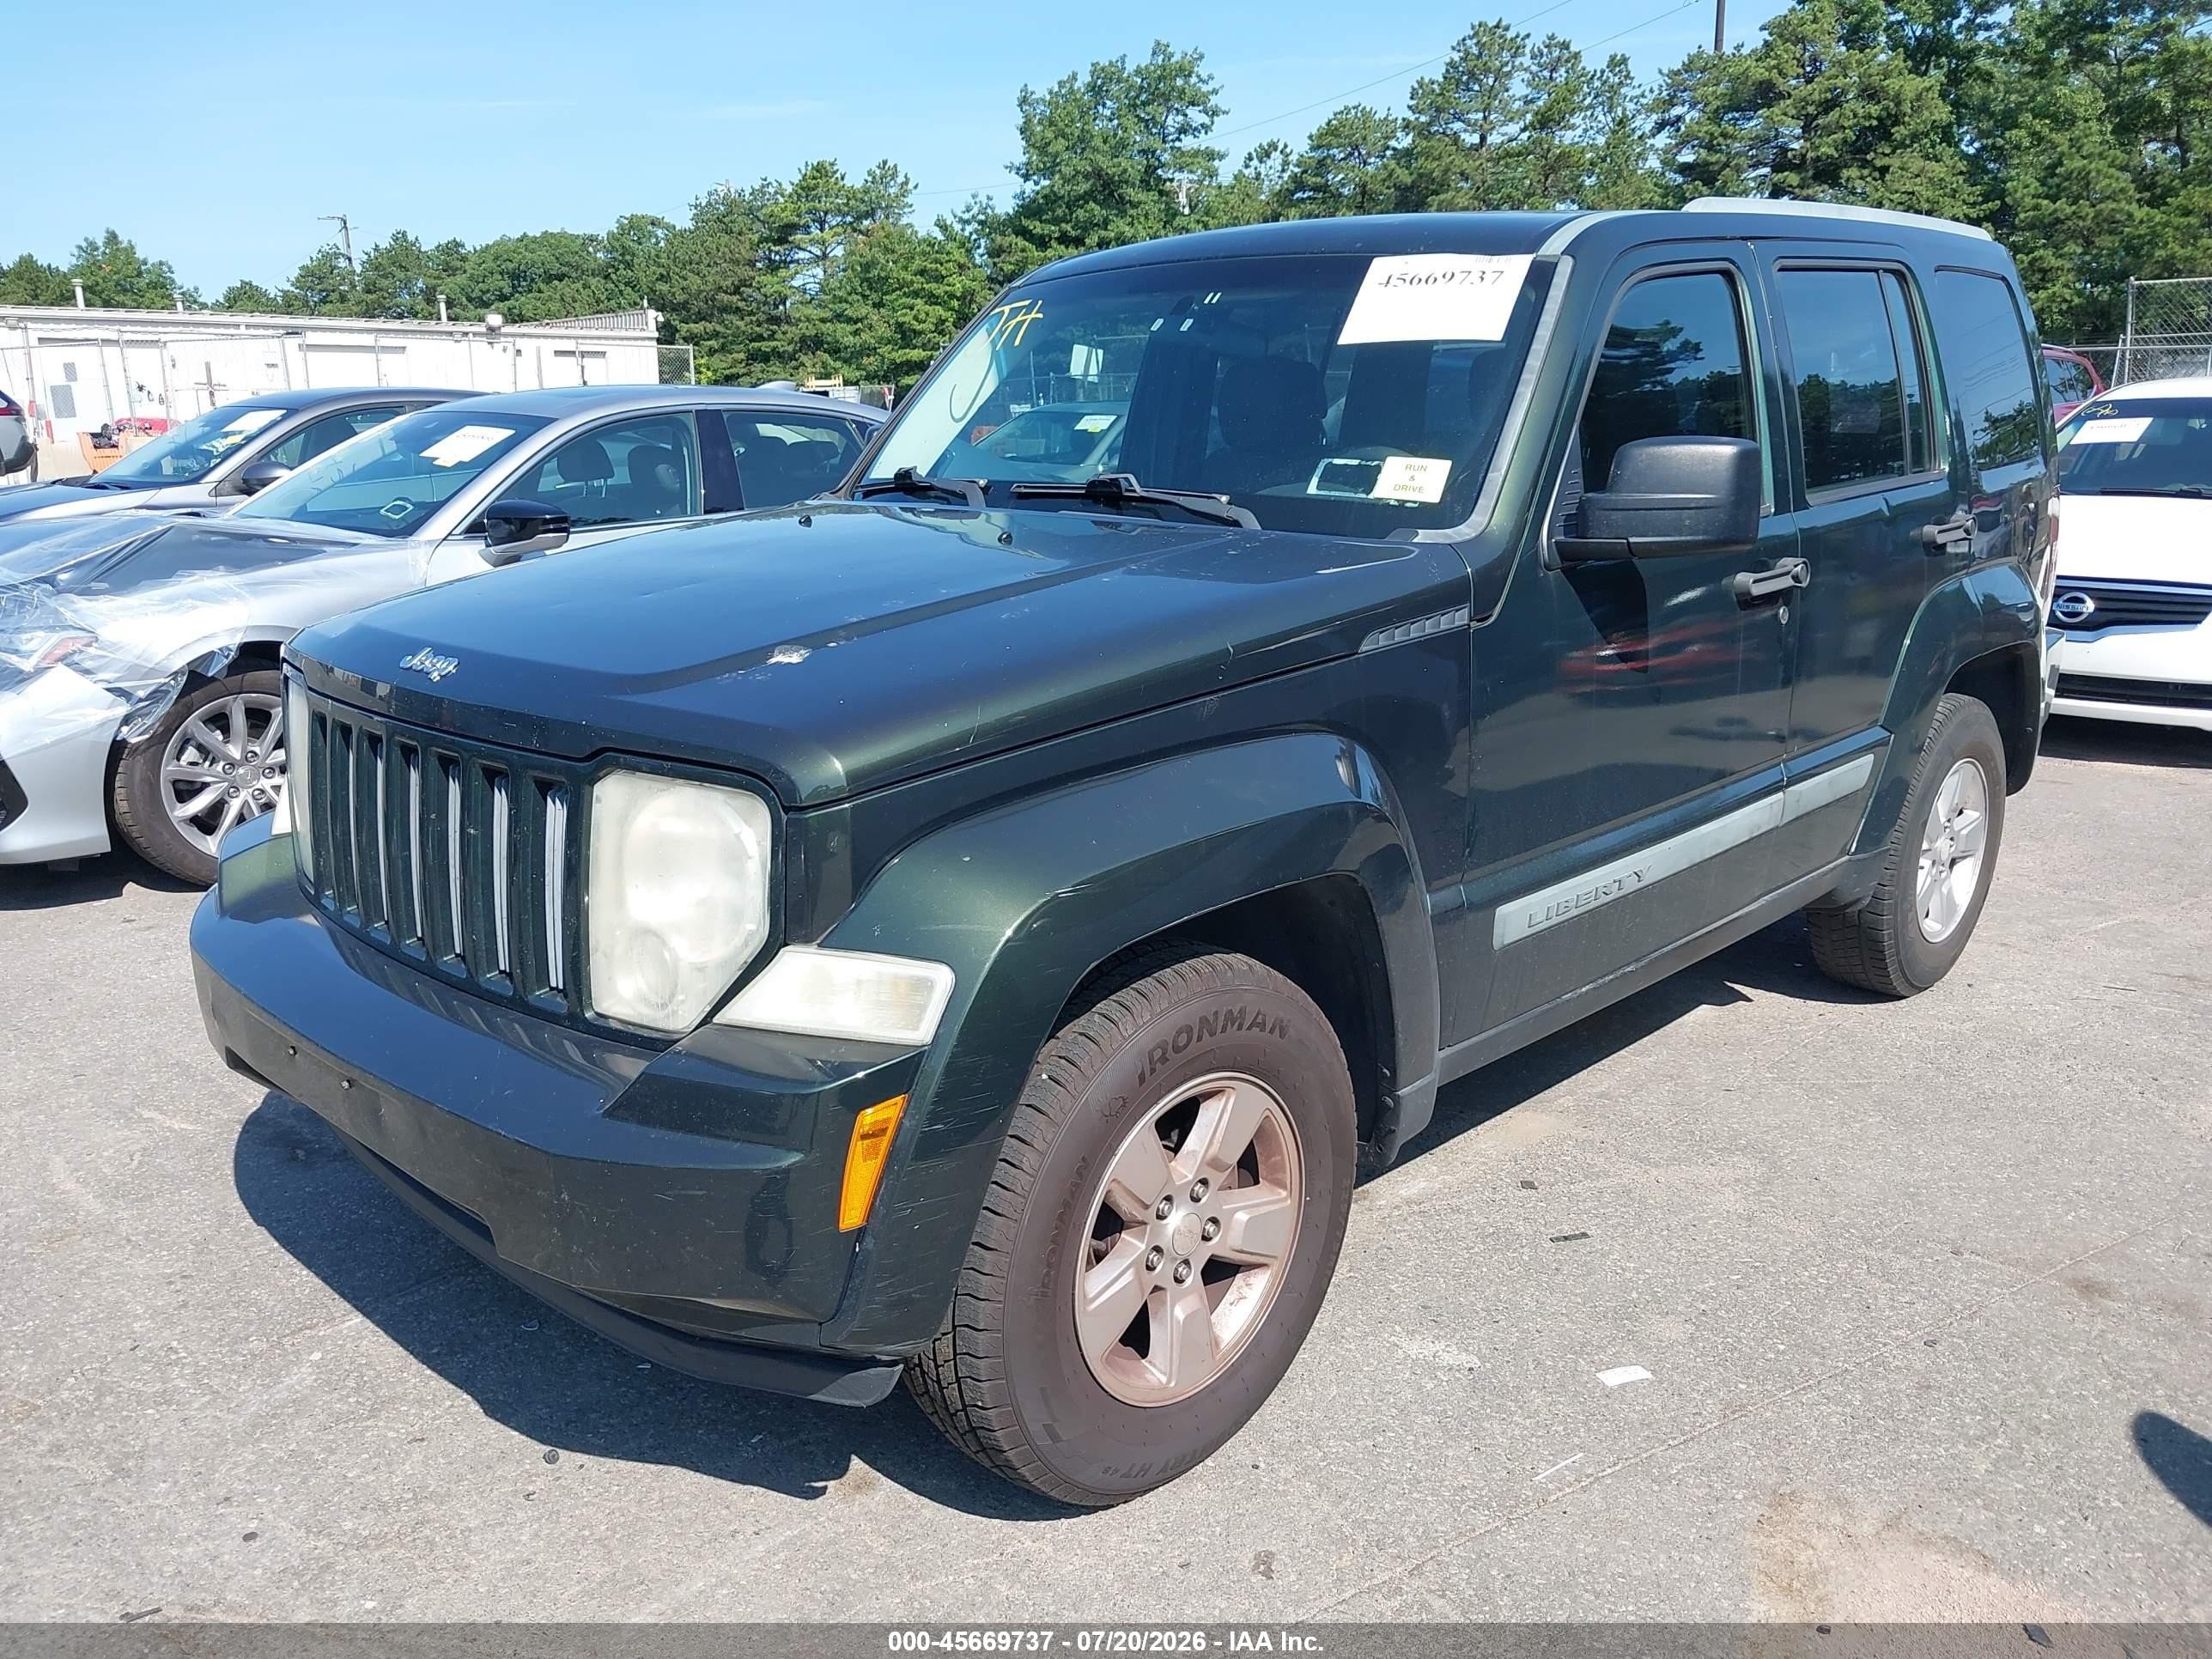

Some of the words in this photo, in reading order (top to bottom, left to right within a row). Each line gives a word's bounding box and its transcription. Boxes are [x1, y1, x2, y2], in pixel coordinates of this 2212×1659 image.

[1377, 270, 1505, 288] 45669737
[1404, 464, 1428, 472] RUN
[1393, 483, 1425, 494] DRIVE
[399, 647, 459, 683] Jeep
[1527, 864, 1653, 928] LIBERTY
[1137, 1005, 1291, 1088] IRONMAN
